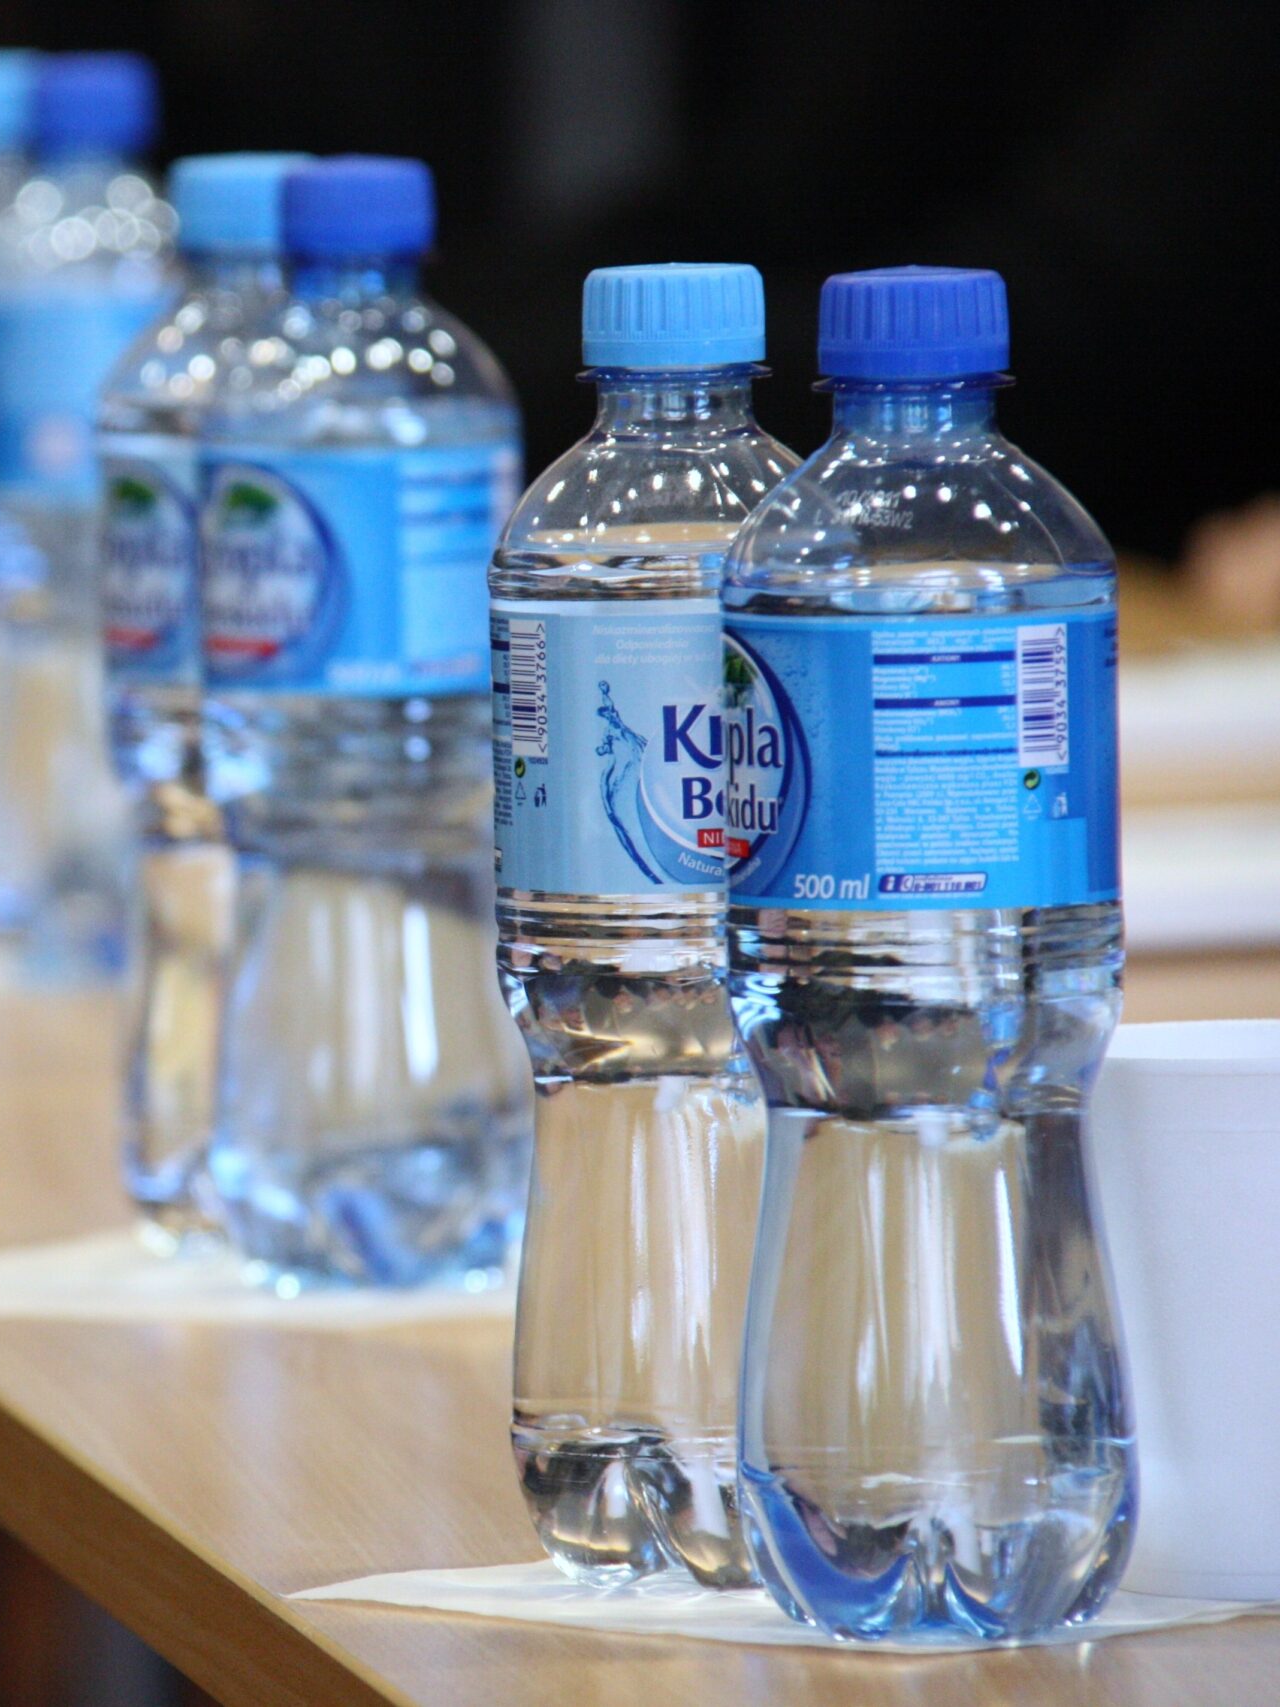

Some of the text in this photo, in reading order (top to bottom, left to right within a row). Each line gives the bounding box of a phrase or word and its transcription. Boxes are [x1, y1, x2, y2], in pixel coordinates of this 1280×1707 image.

[535, 640, 548, 735] 9034 3766
[677, 852, 725, 877] Natura
[794, 873, 870, 899] 500 ml
